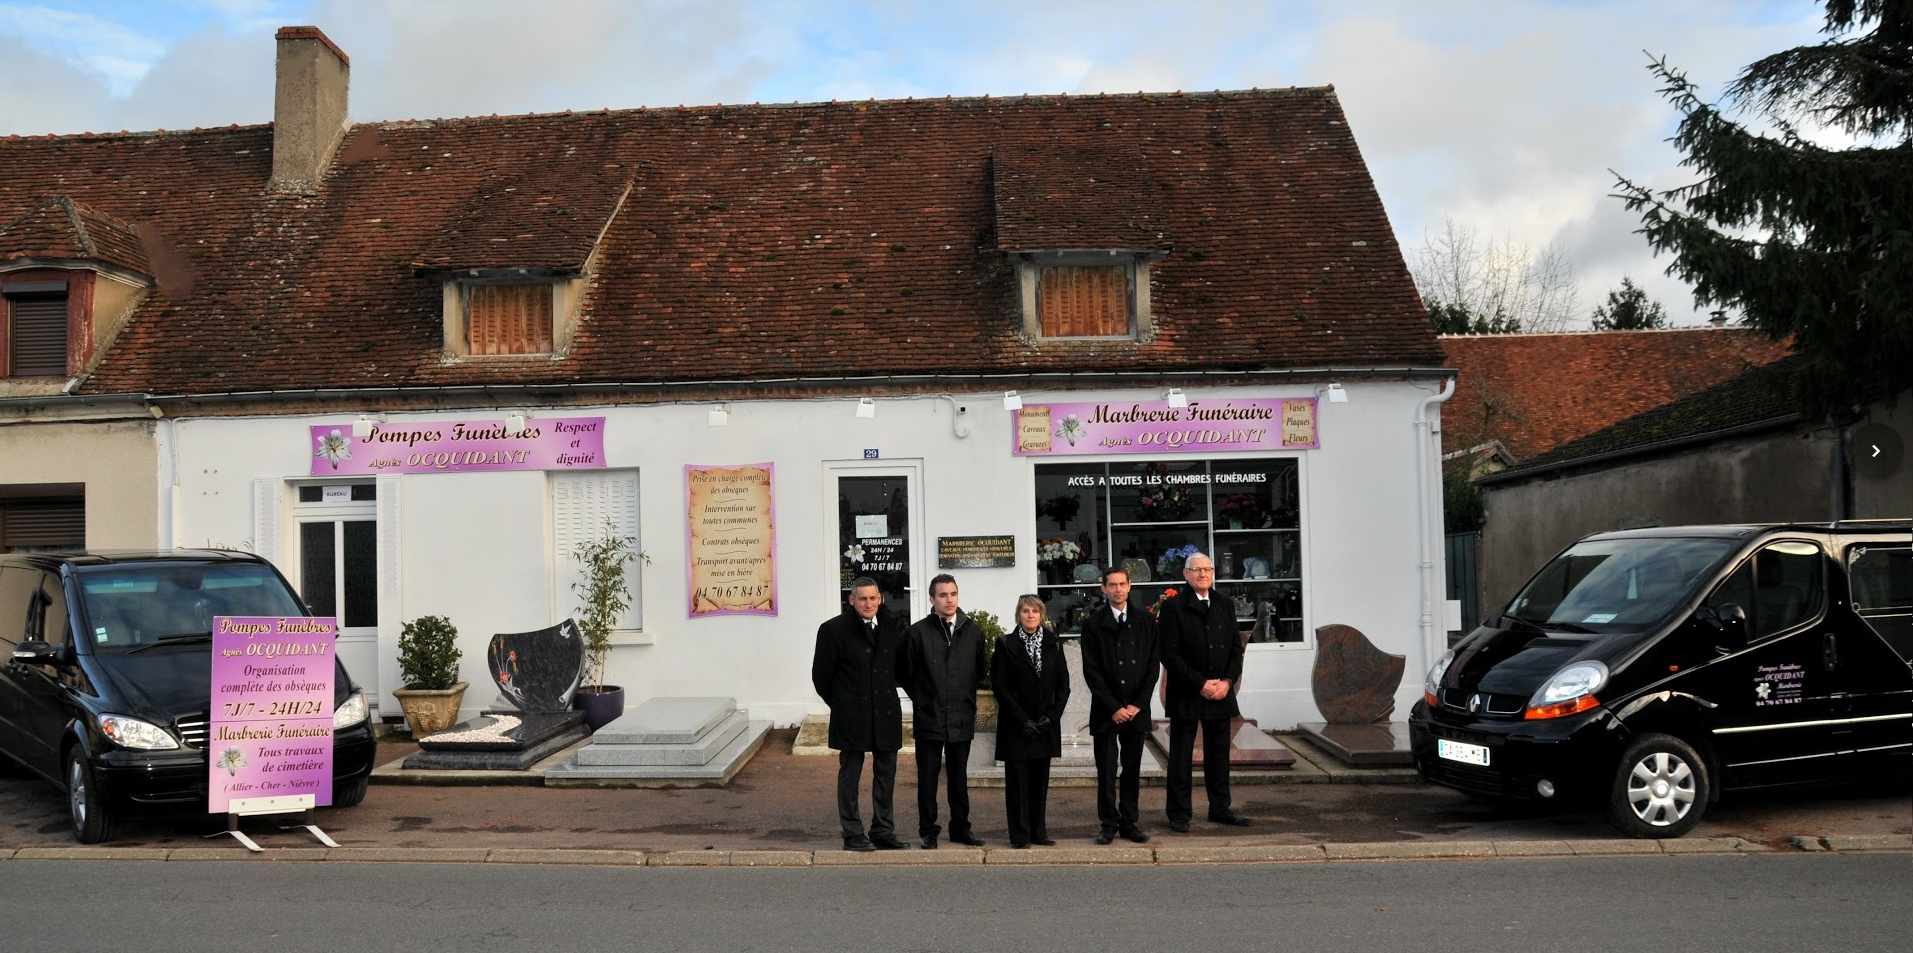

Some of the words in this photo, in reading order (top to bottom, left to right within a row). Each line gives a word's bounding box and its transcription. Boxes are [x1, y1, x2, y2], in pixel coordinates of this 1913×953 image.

[1088, 403, 1180, 424] Marbrerie
[1187, 402, 1273, 421] Funéraire
[555, 422, 597, 434] Respect
[362, 426, 441, 447] Pompes
[1100, 436, 1132, 447] Agnès
[1137, 429, 1266, 446] OCQUIDANT
[570, 439, 581, 448] et
[368, 457, 401, 468] Agnès
[407, 450, 531, 469] OCQUIDANT
[557, 452, 595, 465] dignité
[865, 450, 878, 458] 29
[1068, 475, 1094, 486] ACCÈS
[1099, 476, 1105, 485] A
[1110, 475, 1142, 485] TOUTES
[1147, 474, 1162, 484] LES
[1166, 473, 1211, 484] CHAMBRES
[1215, 471, 1266, 483] FUNÉRAIRES
[704, 505, 744, 513] Intervention
[724, 517, 758, 525] communes
[702, 537, 729, 546] Contrats
[731, 537, 760, 547] obsèques
[696, 557, 728, 568] Transport
[862, 563, 869, 571] 04
[696, 587, 707, 598] 04
[712, 586, 723, 598] 70
[726, 586, 738, 597] 67
[741, 585, 752, 596] 84
[756, 585, 768, 596] 87
[219, 619, 271, 638] Pompes
[276, 618, 332, 633] Funèbres
[222, 648, 242, 657] Agnès
[247, 643, 329, 659] OCQUIDANT
[244, 664, 305, 678] Organisation
[1765, 671, 1805, 682] OCQUIDANT
[221, 681, 264, 695] complète
[267, 682, 281, 692] des
[285, 681, 326, 695] obsèques
[224, 702, 255, 717] 7J/7
[270, 701, 322, 715] 24H/24
[214, 725, 273, 741] Marbrerie
[276, 724, 330, 738] Funéraire
[258, 747, 282, 757] Tous
[284, 746, 324, 756] travaux
[262, 763, 274, 773] de
[277, 761, 324, 771] cimetière
[231, 783, 253, 791] Allier
[261, 781, 281, 789] Cher
[289, 779, 314, 788] Nièvre
